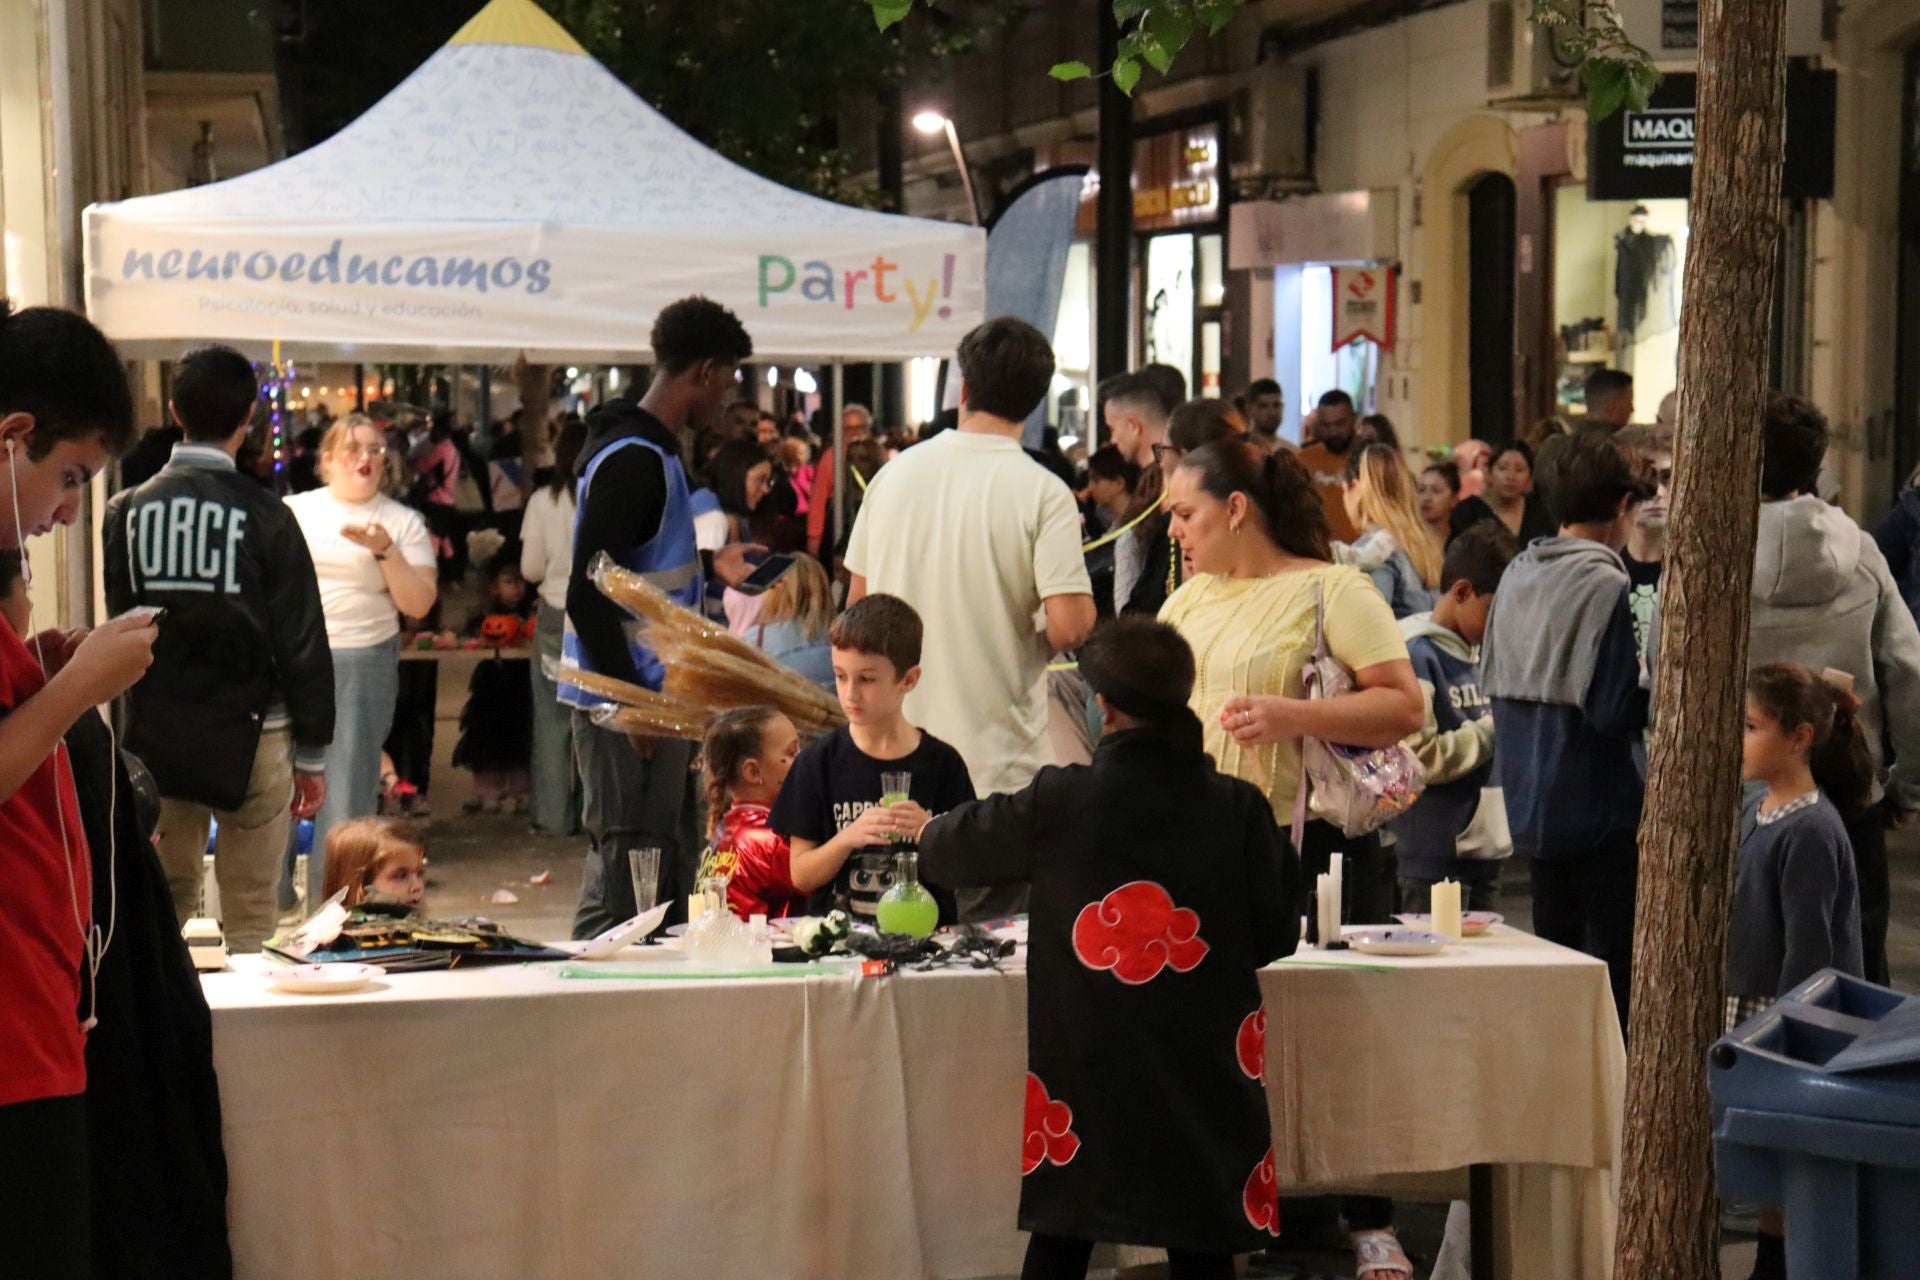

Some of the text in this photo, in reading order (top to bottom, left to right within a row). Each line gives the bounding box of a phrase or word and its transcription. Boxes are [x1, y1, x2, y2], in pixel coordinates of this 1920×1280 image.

[121, 239, 551, 294] neuroeducamos
[757, 253, 956, 333] Party!
[308, 298, 360, 316] salud
[366, 301, 377, 318] y
[381, 299, 482, 319] educación
[126, 496, 247, 594] FORCE
